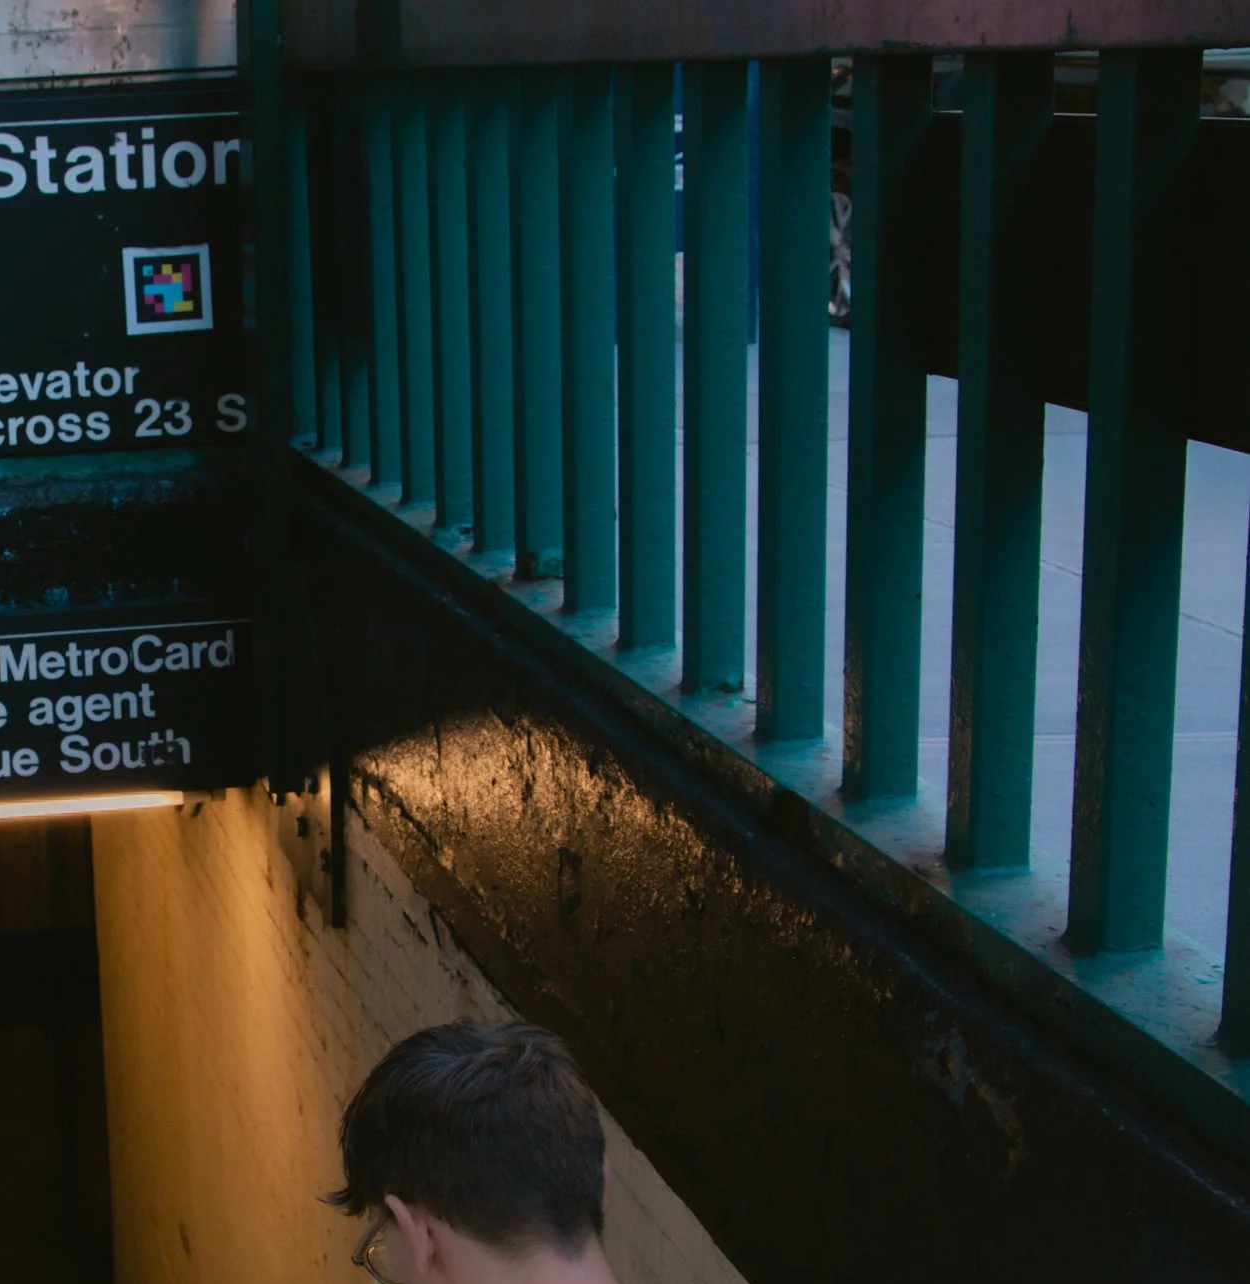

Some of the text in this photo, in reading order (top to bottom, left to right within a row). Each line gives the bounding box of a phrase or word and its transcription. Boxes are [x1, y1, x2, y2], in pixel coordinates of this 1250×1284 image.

[134, 398, 193, 437] 23
[28, 682, 157, 733] agent
[60, 728, 191, 774] South
